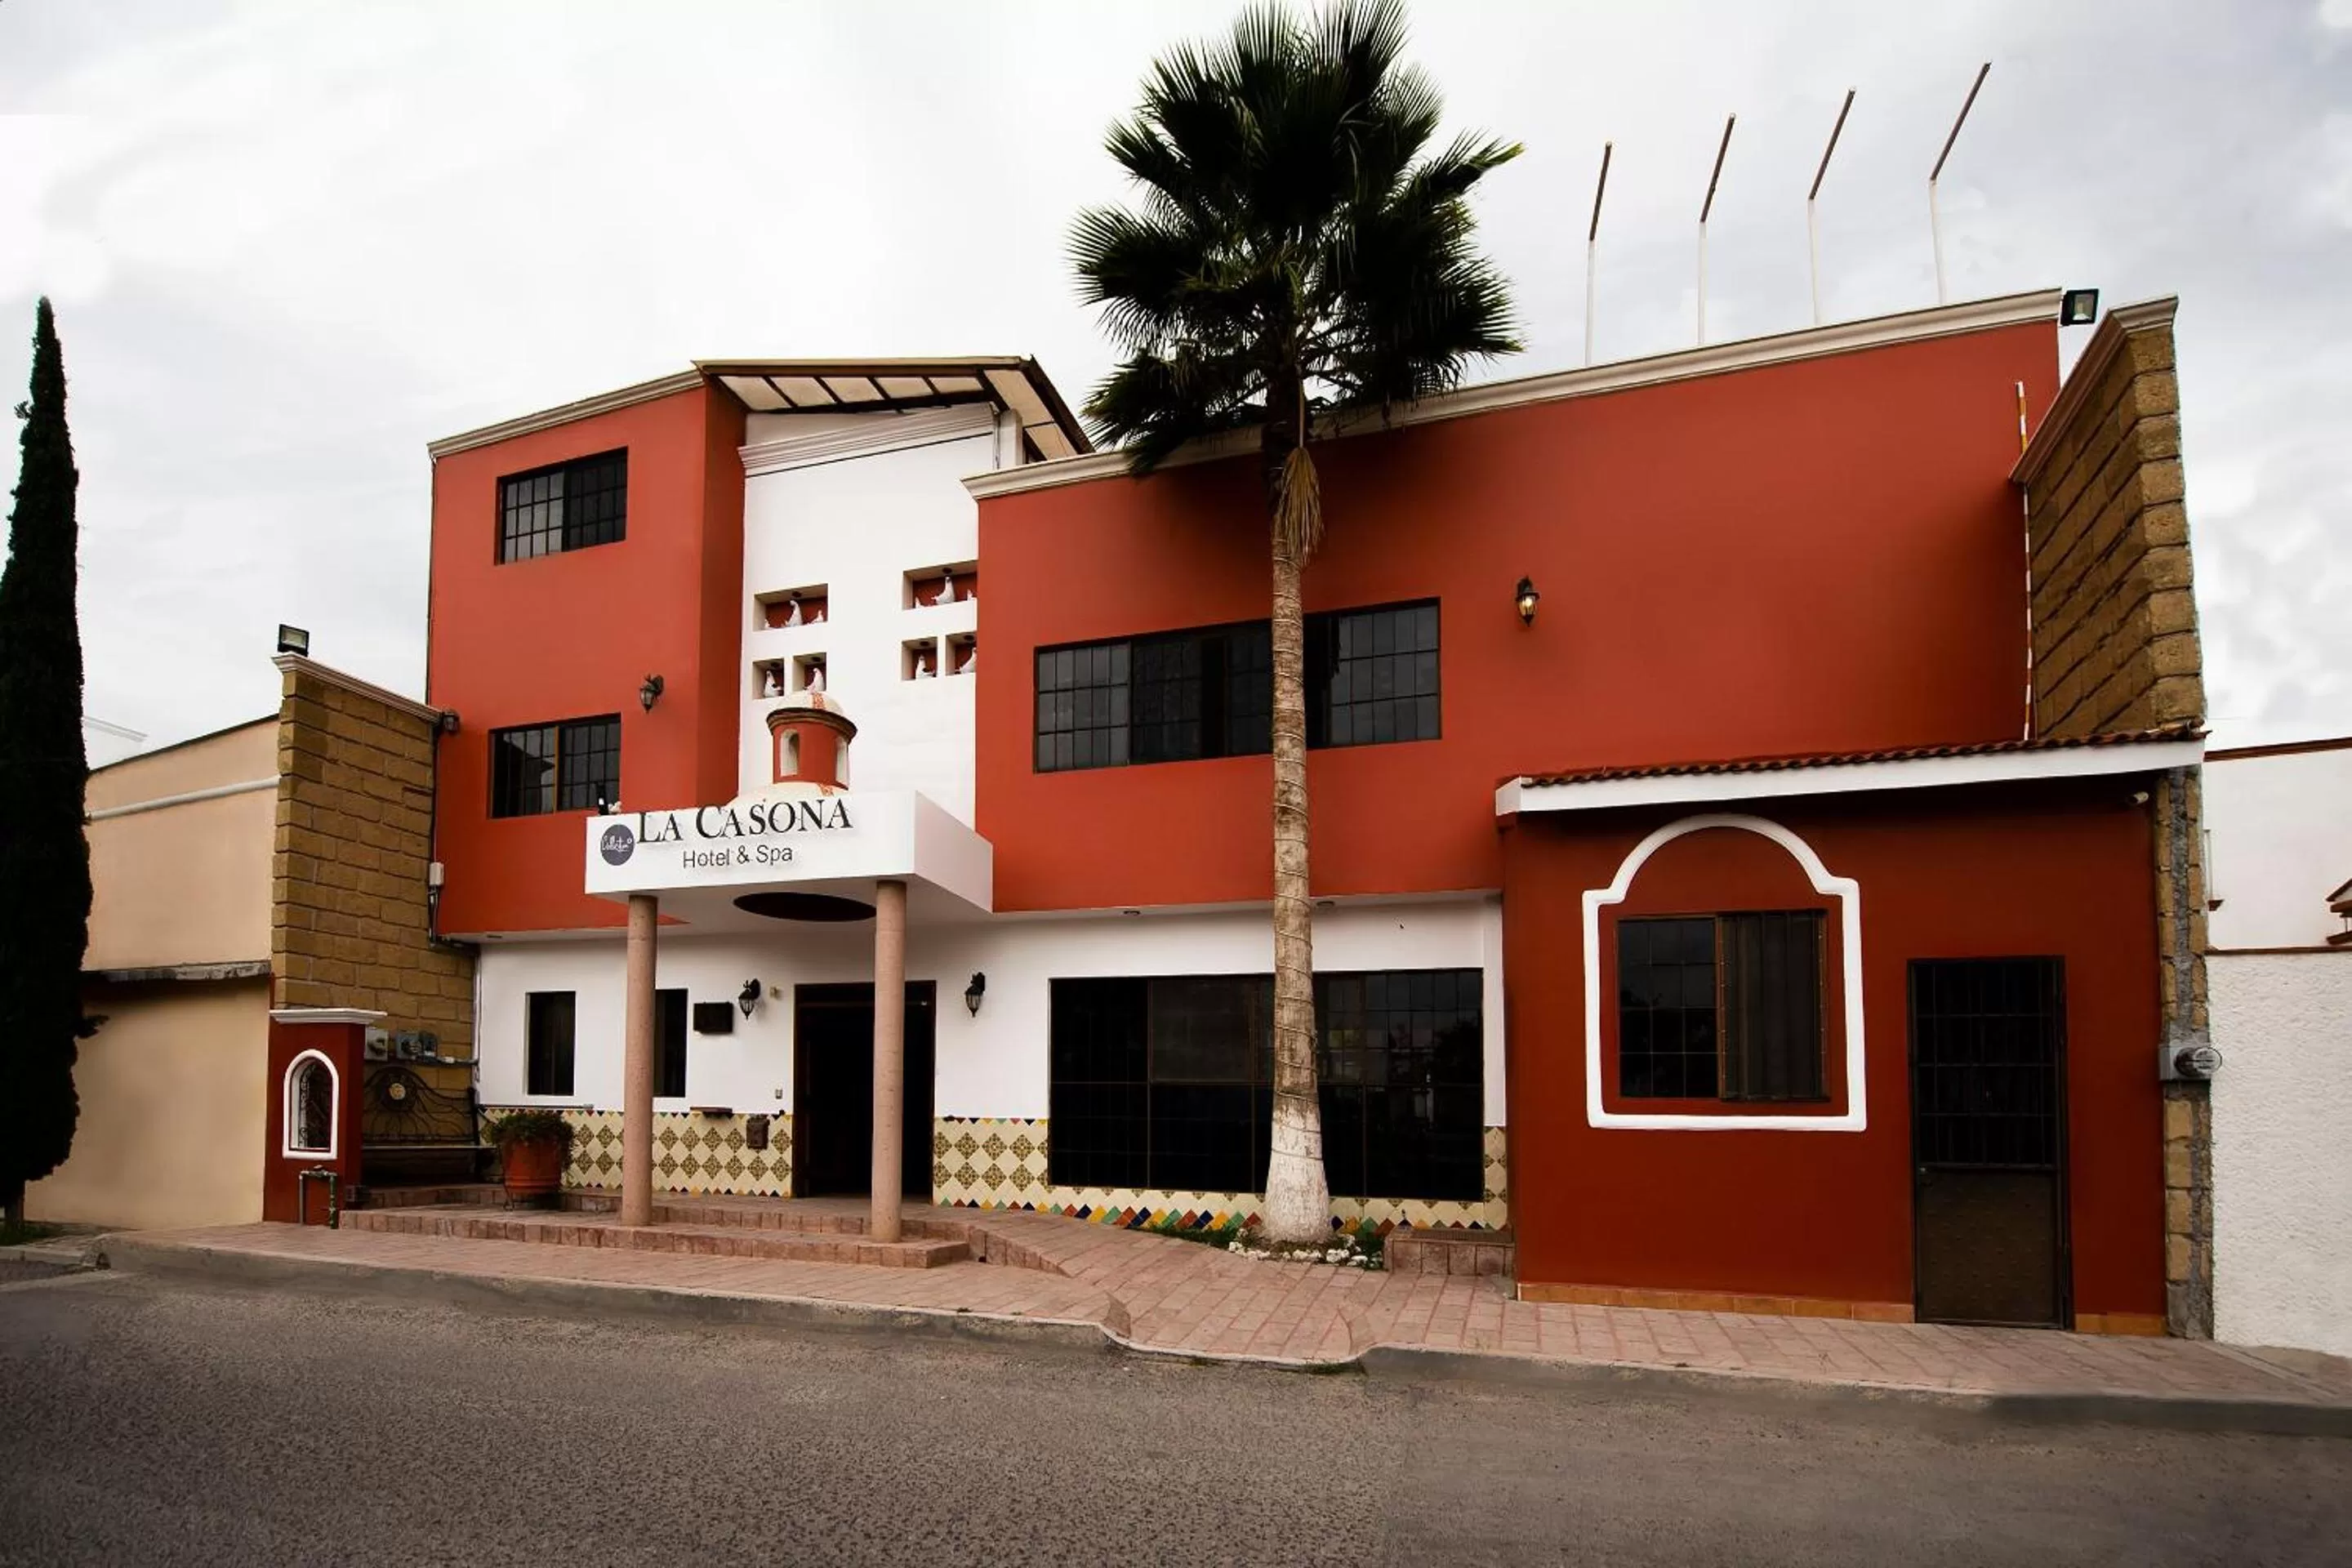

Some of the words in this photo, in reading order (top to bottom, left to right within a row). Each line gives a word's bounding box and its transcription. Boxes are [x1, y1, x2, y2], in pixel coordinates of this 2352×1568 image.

[637, 812, 684, 844] LA
[696, 798, 853, 840] CASONA
[683, 845, 730, 869] Hotel
[737, 845, 751, 862] &
[756, 844, 793, 864] Spa
